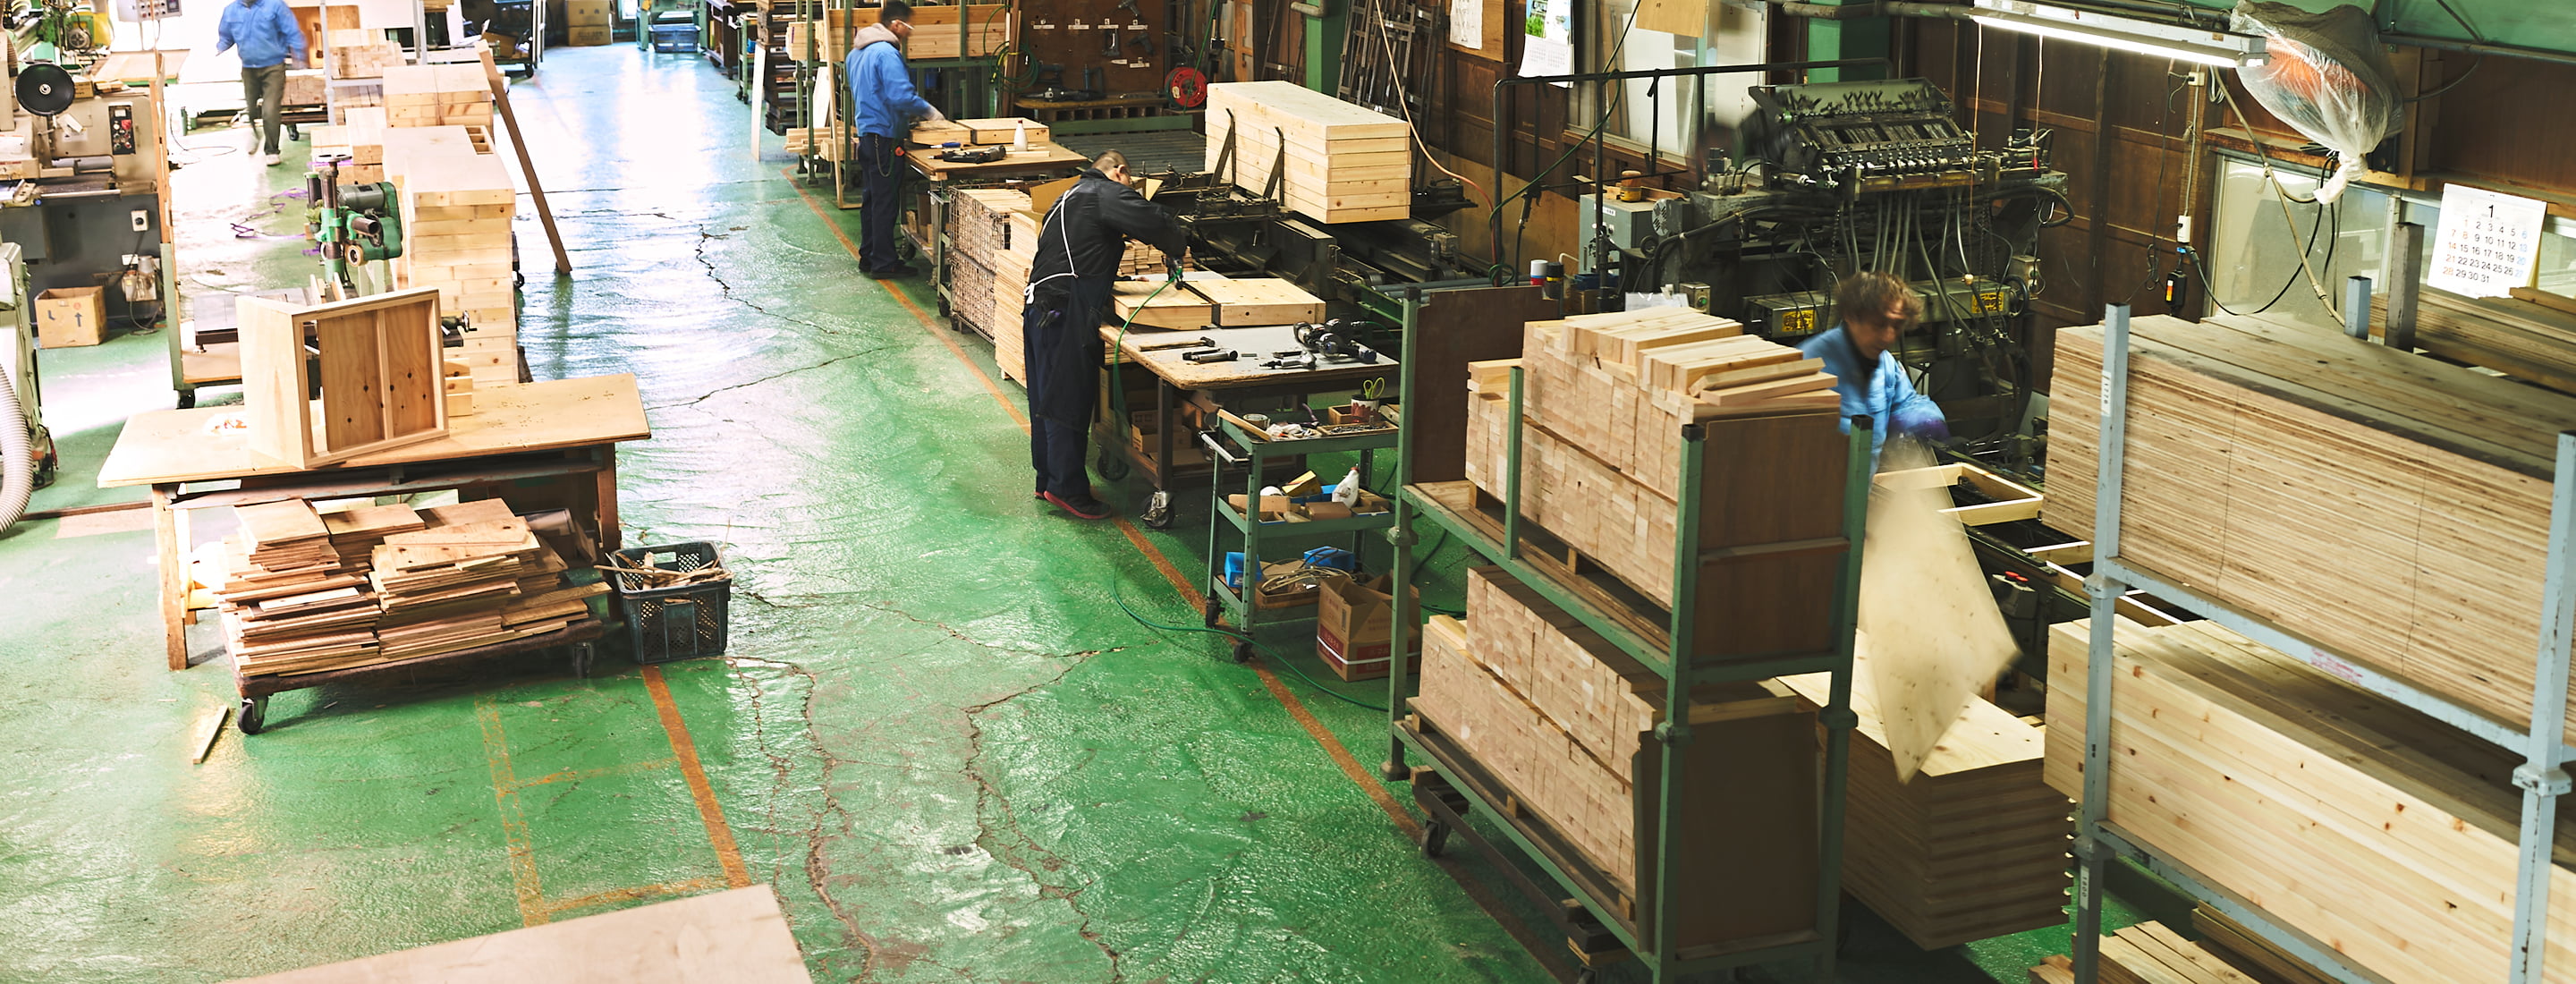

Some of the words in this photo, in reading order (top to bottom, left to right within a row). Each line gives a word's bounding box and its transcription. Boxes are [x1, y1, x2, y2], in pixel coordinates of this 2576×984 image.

[2487, 204, 2494, 218] 1
[2476, 221, 2481, 229] 2
[2487, 223, 2493, 232] 3
[2511, 228, 2516, 236] 5
[2451, 229, 2456, 237] 7
[2462, 231, 2468, 240] 8
[2474, 233, 2480, 242] 9
[2485, 236, 2494, 244] 10
[2497, 239, 2504, 247] 11
[2508, 241, 2516, 250] 12
[2520, 244, 2527, 252] 13
[2448, 242, 2456, 250] 14
[2461, 244, 2469, 252] 15
[2472, 247, 2480, 255] 16
[2484, 249, 2492, 258] 17
[2496, 251, 2504, 260] 18
[2505, 253, 2514, 263] 19
[2517, 256, 2526, 265] 20
[2445, 254, 2455, 262] 21
[2458, 256, 2468, 266] 22
[2470, 259, 2479, 267] 23
[2481, 261, 2490, 270] 24
[2493, 264, 2503, 273] 25
[2504, 267, 2513, 276] 26
[2443, 267, 2453, 276] 28
[2455, 268, 2467, 278] 29
[2468, 271, 2479, 281] 30
[2480, 274, 2489, 283] 31
